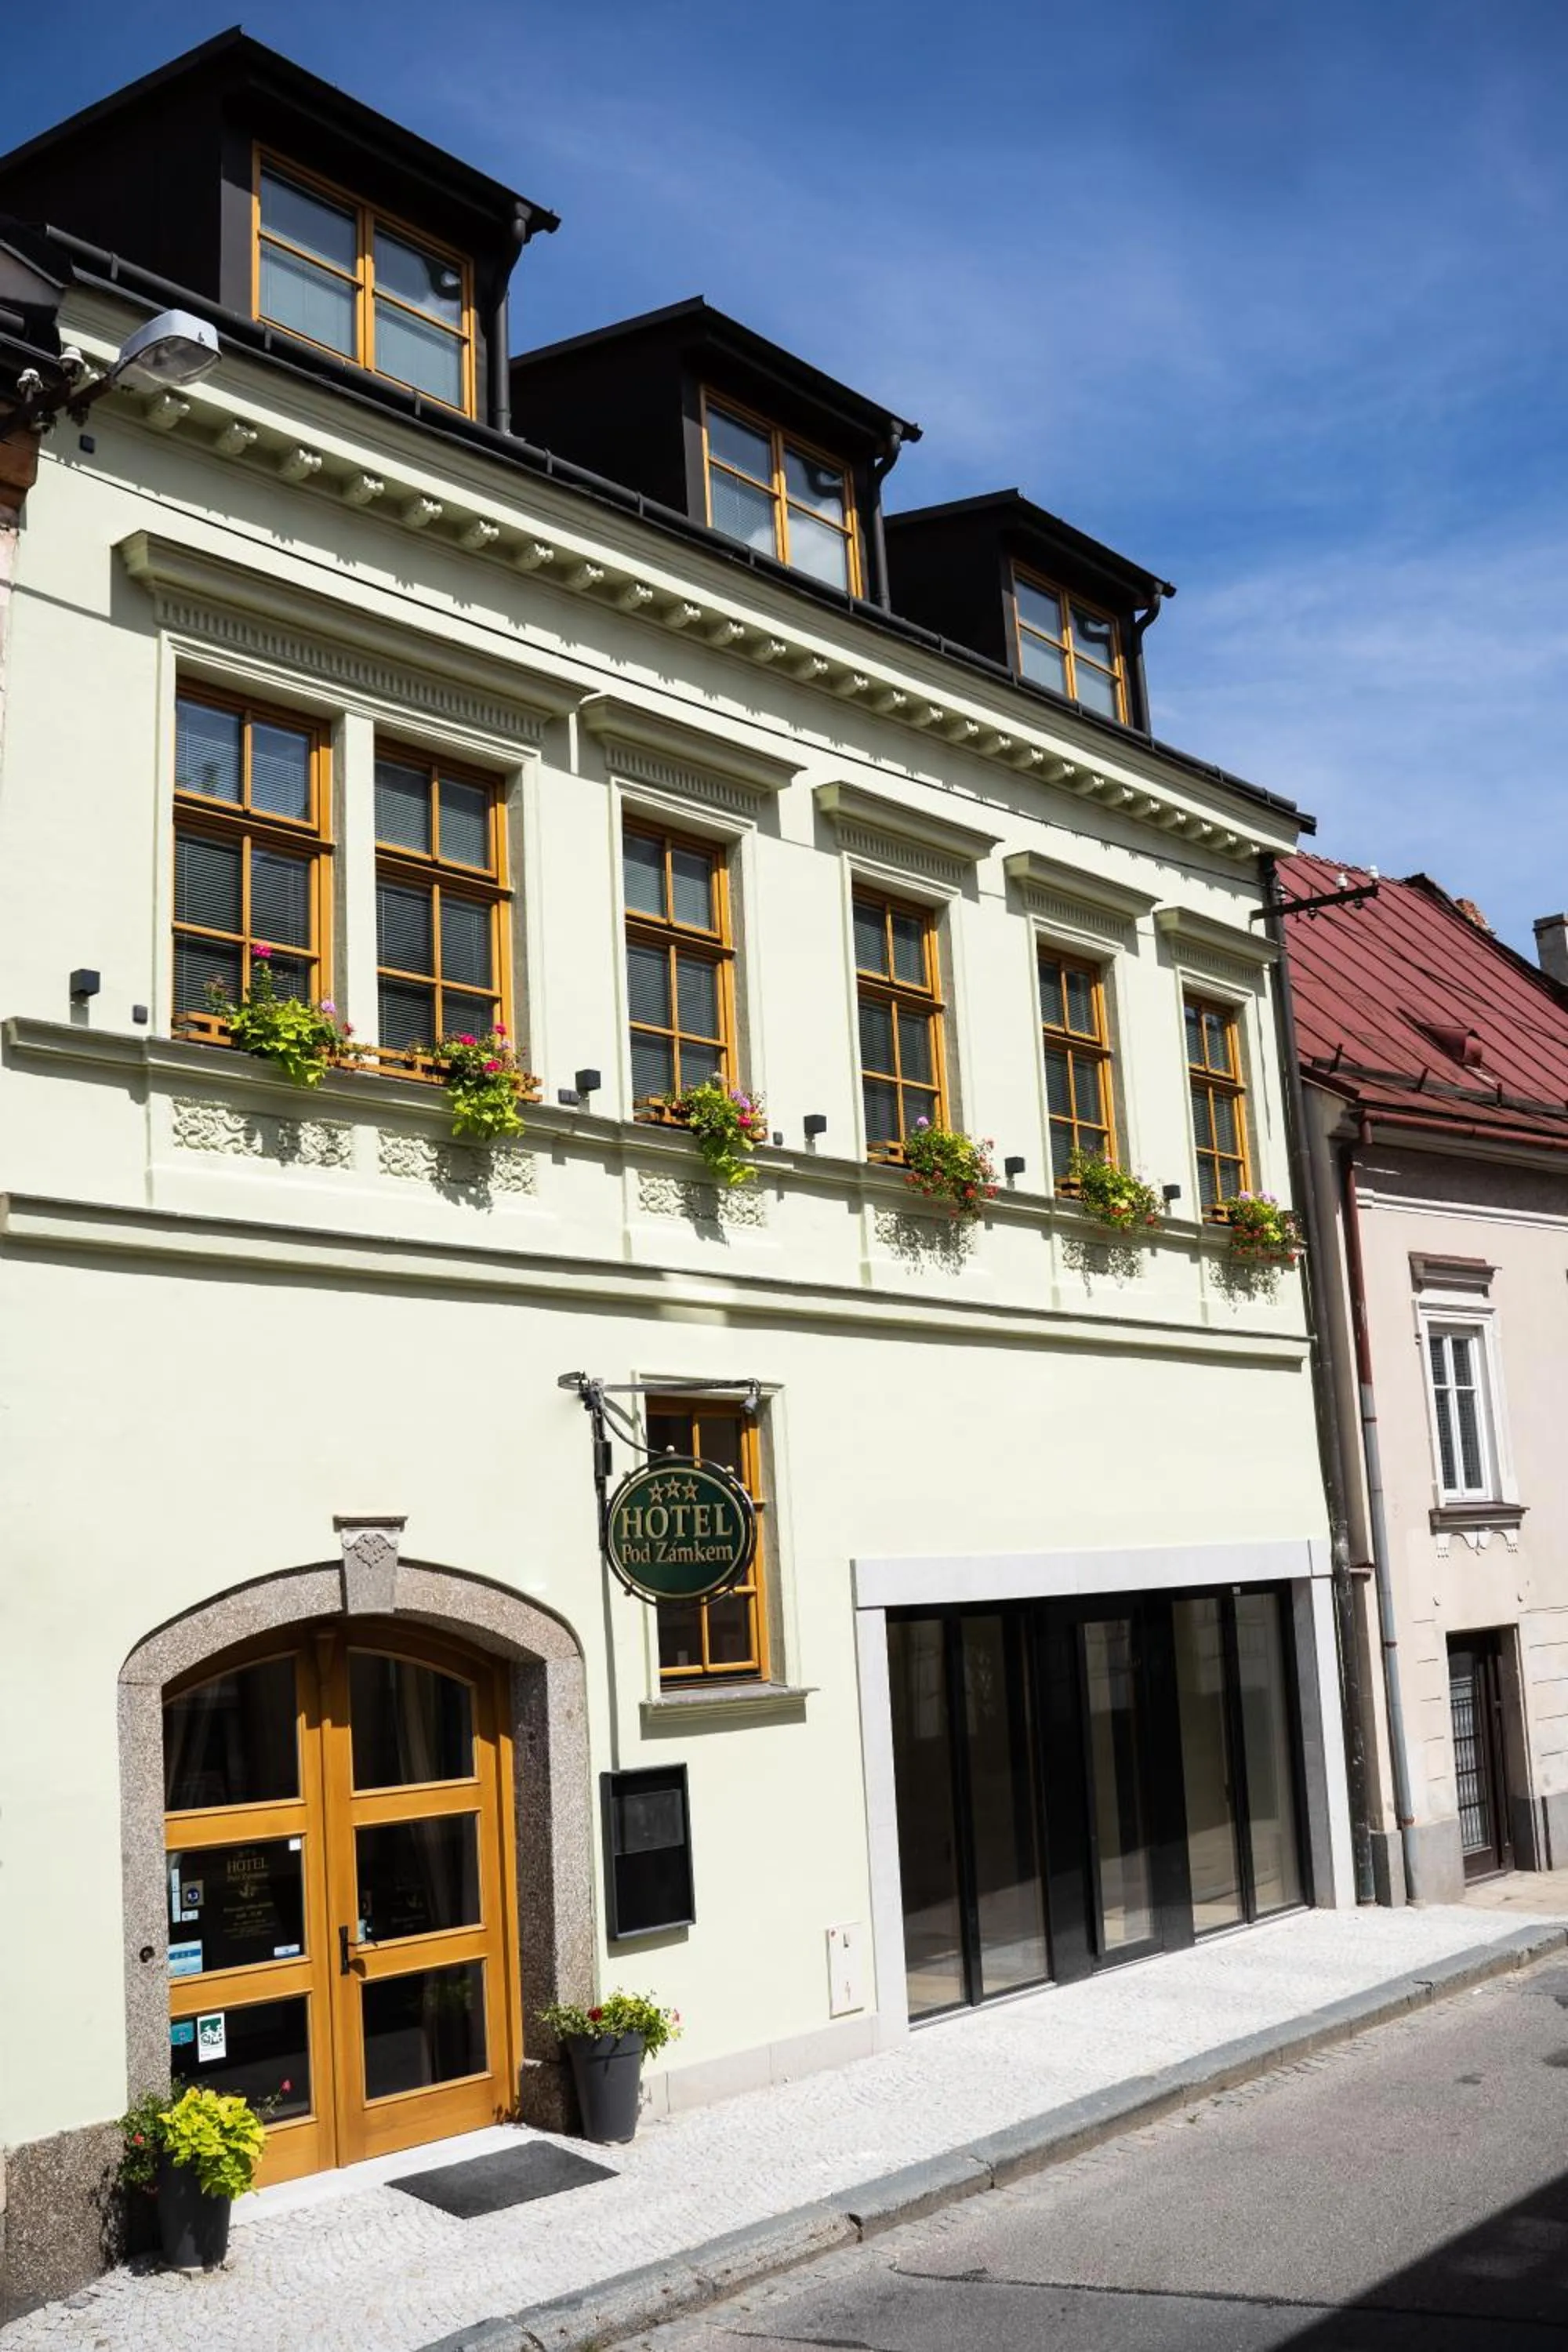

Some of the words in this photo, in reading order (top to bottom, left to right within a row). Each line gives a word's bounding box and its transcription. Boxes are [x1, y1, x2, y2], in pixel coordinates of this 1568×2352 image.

[621, 1504, 733, 1539] HOTEL
[622, 1543, 650, 1564] Pod
[656, 1541, 733, 1563] Zámkem
[227, 1857, 268, 1873] HOTEL
